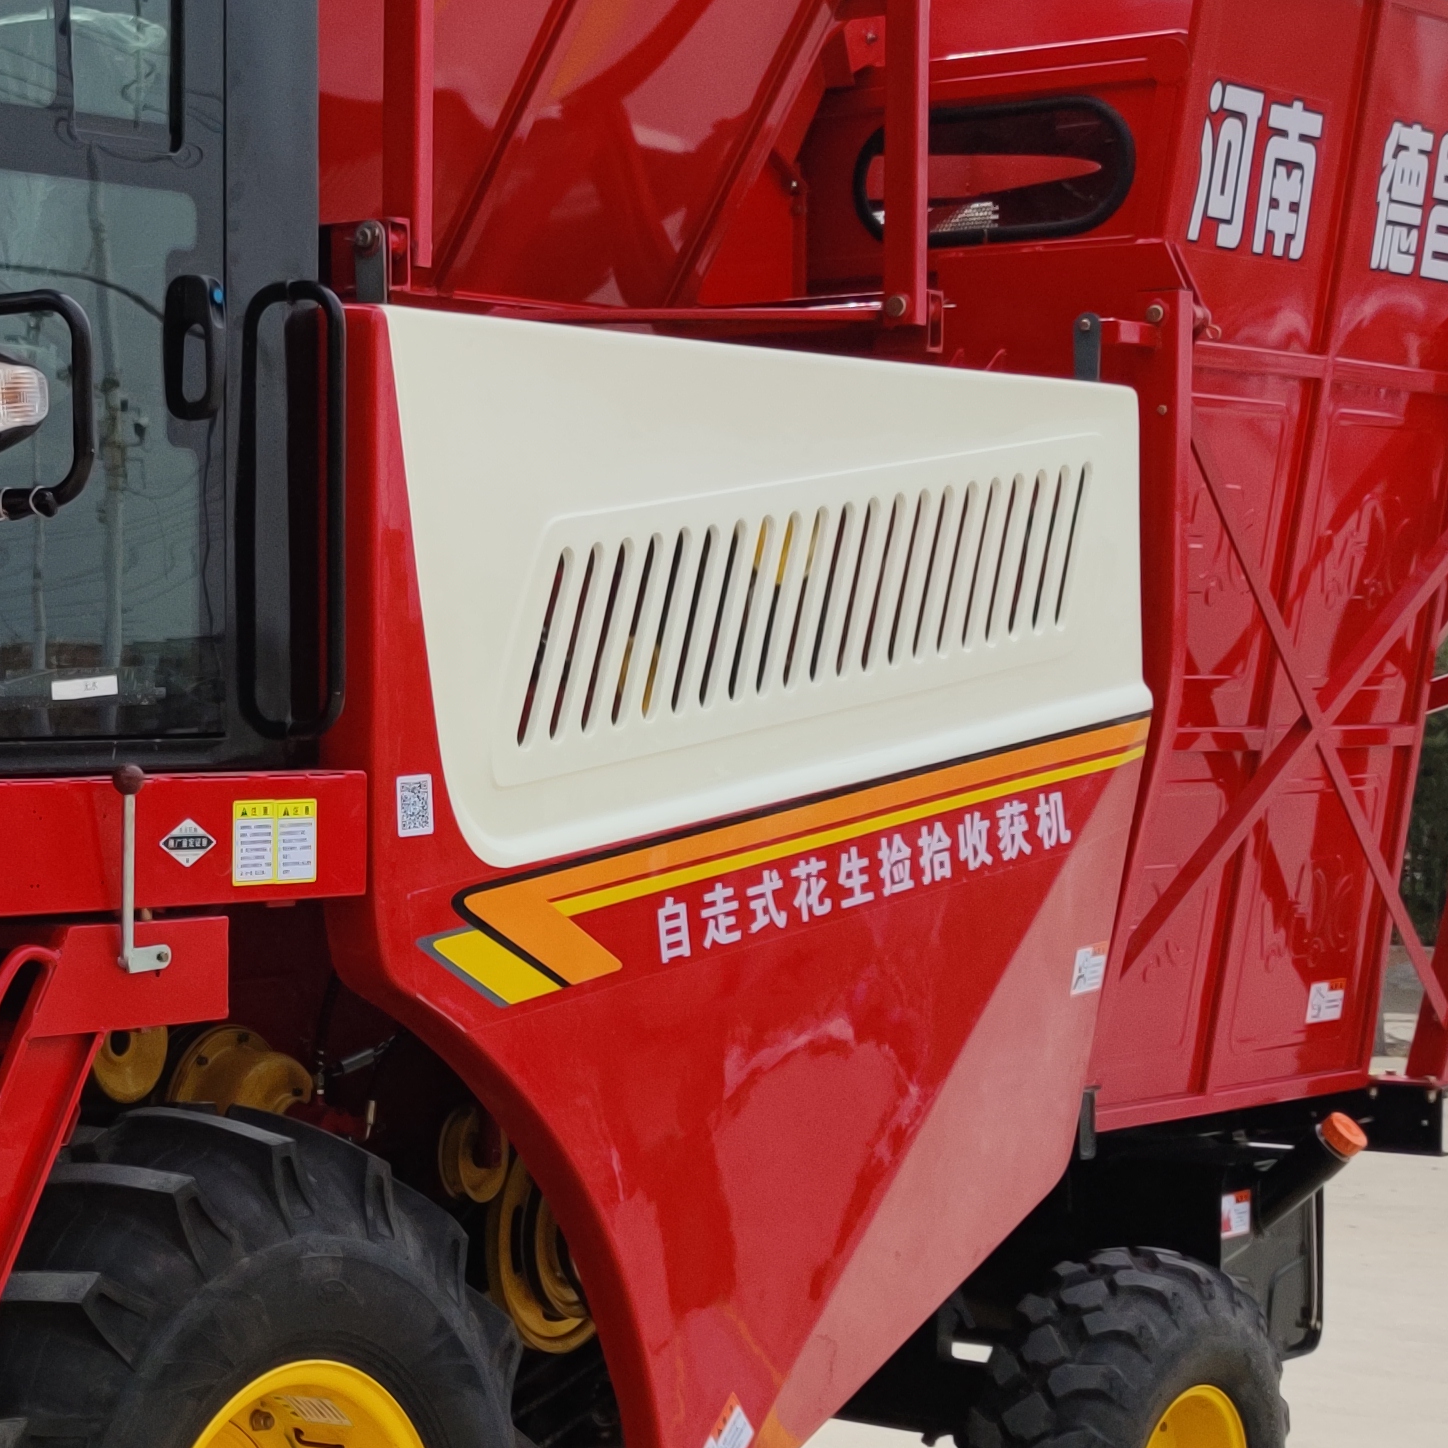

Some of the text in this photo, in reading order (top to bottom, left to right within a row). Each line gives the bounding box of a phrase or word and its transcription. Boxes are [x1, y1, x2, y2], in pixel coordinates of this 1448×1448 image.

[1186, 80, 1324, 260] 河南
[656, 791, 1072, 964] 自走式花生捡拾收获机
